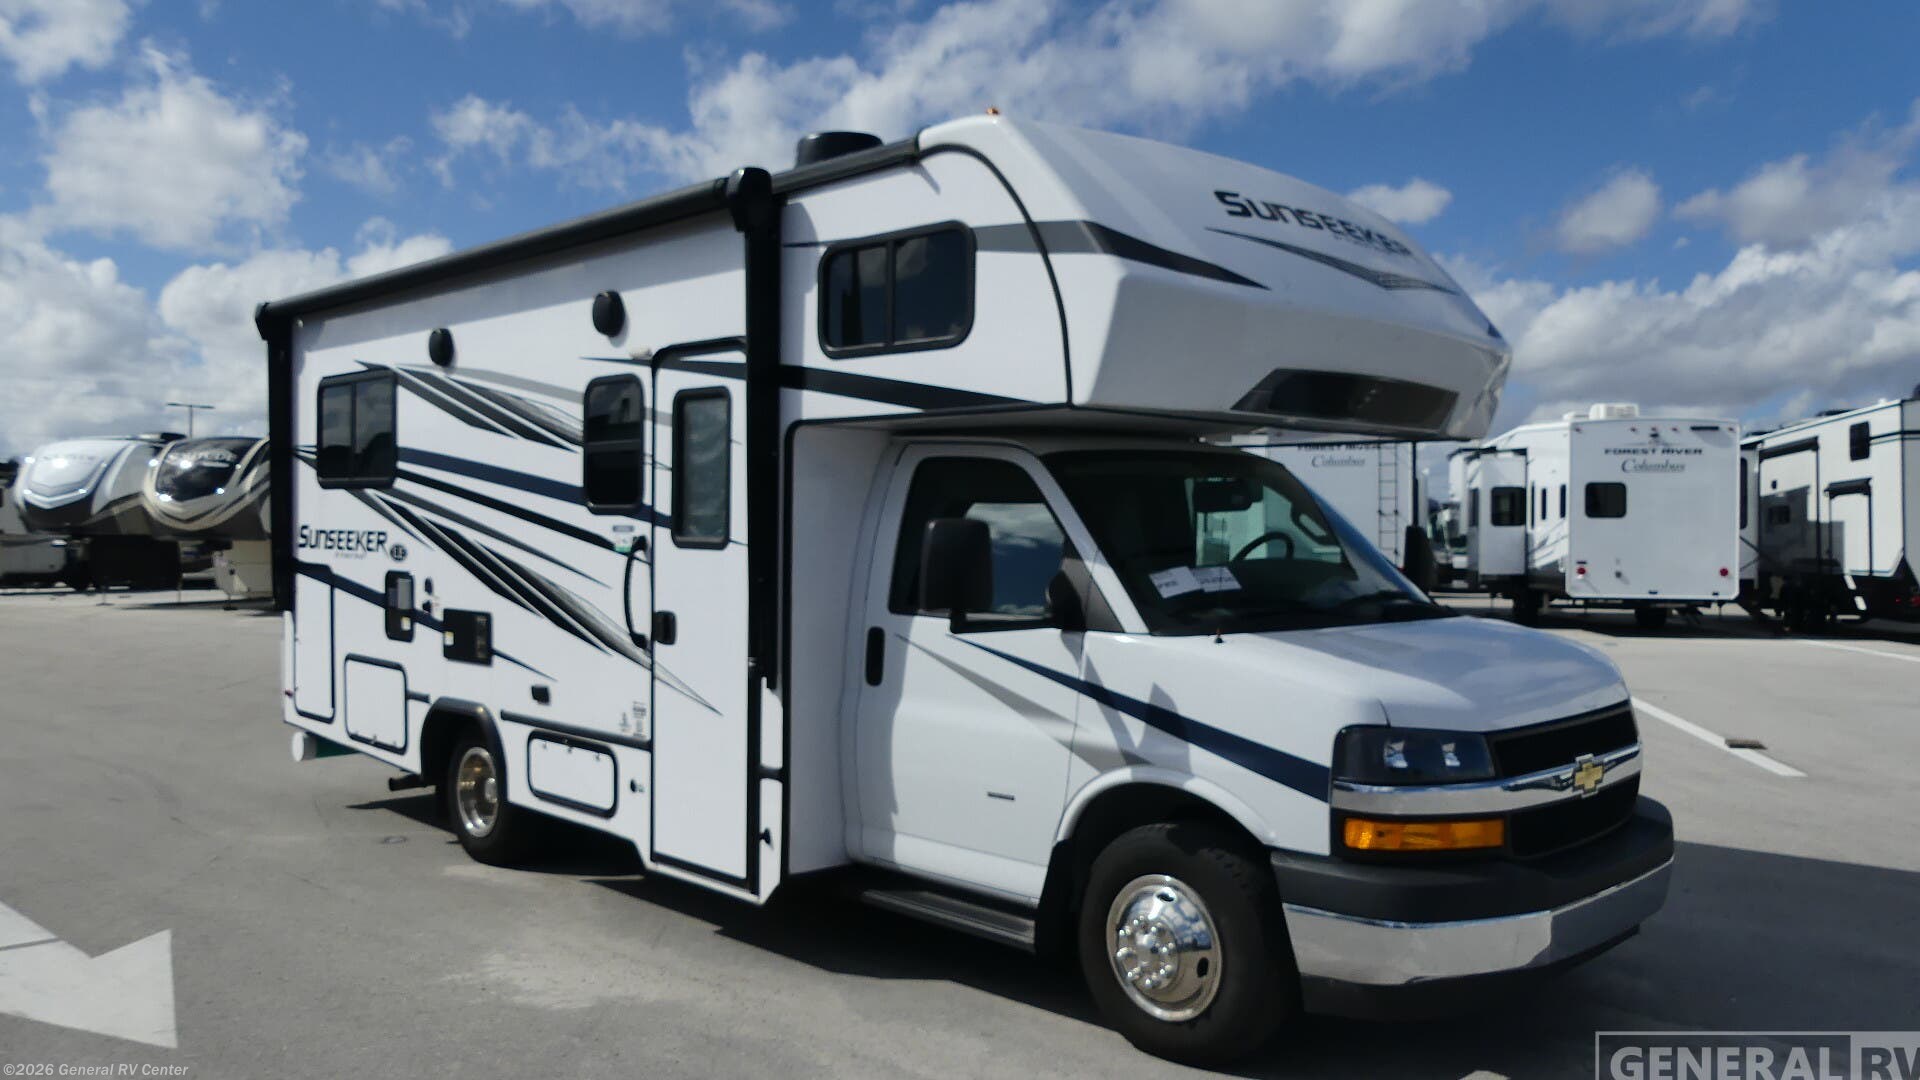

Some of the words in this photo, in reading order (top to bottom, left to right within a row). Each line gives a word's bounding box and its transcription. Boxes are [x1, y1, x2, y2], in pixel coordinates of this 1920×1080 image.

[1604, 447, 1656, 455] FOREST
[1661, 447, 1703, 455] RIVER
[1621, 458, 1686, 474] Columbus
